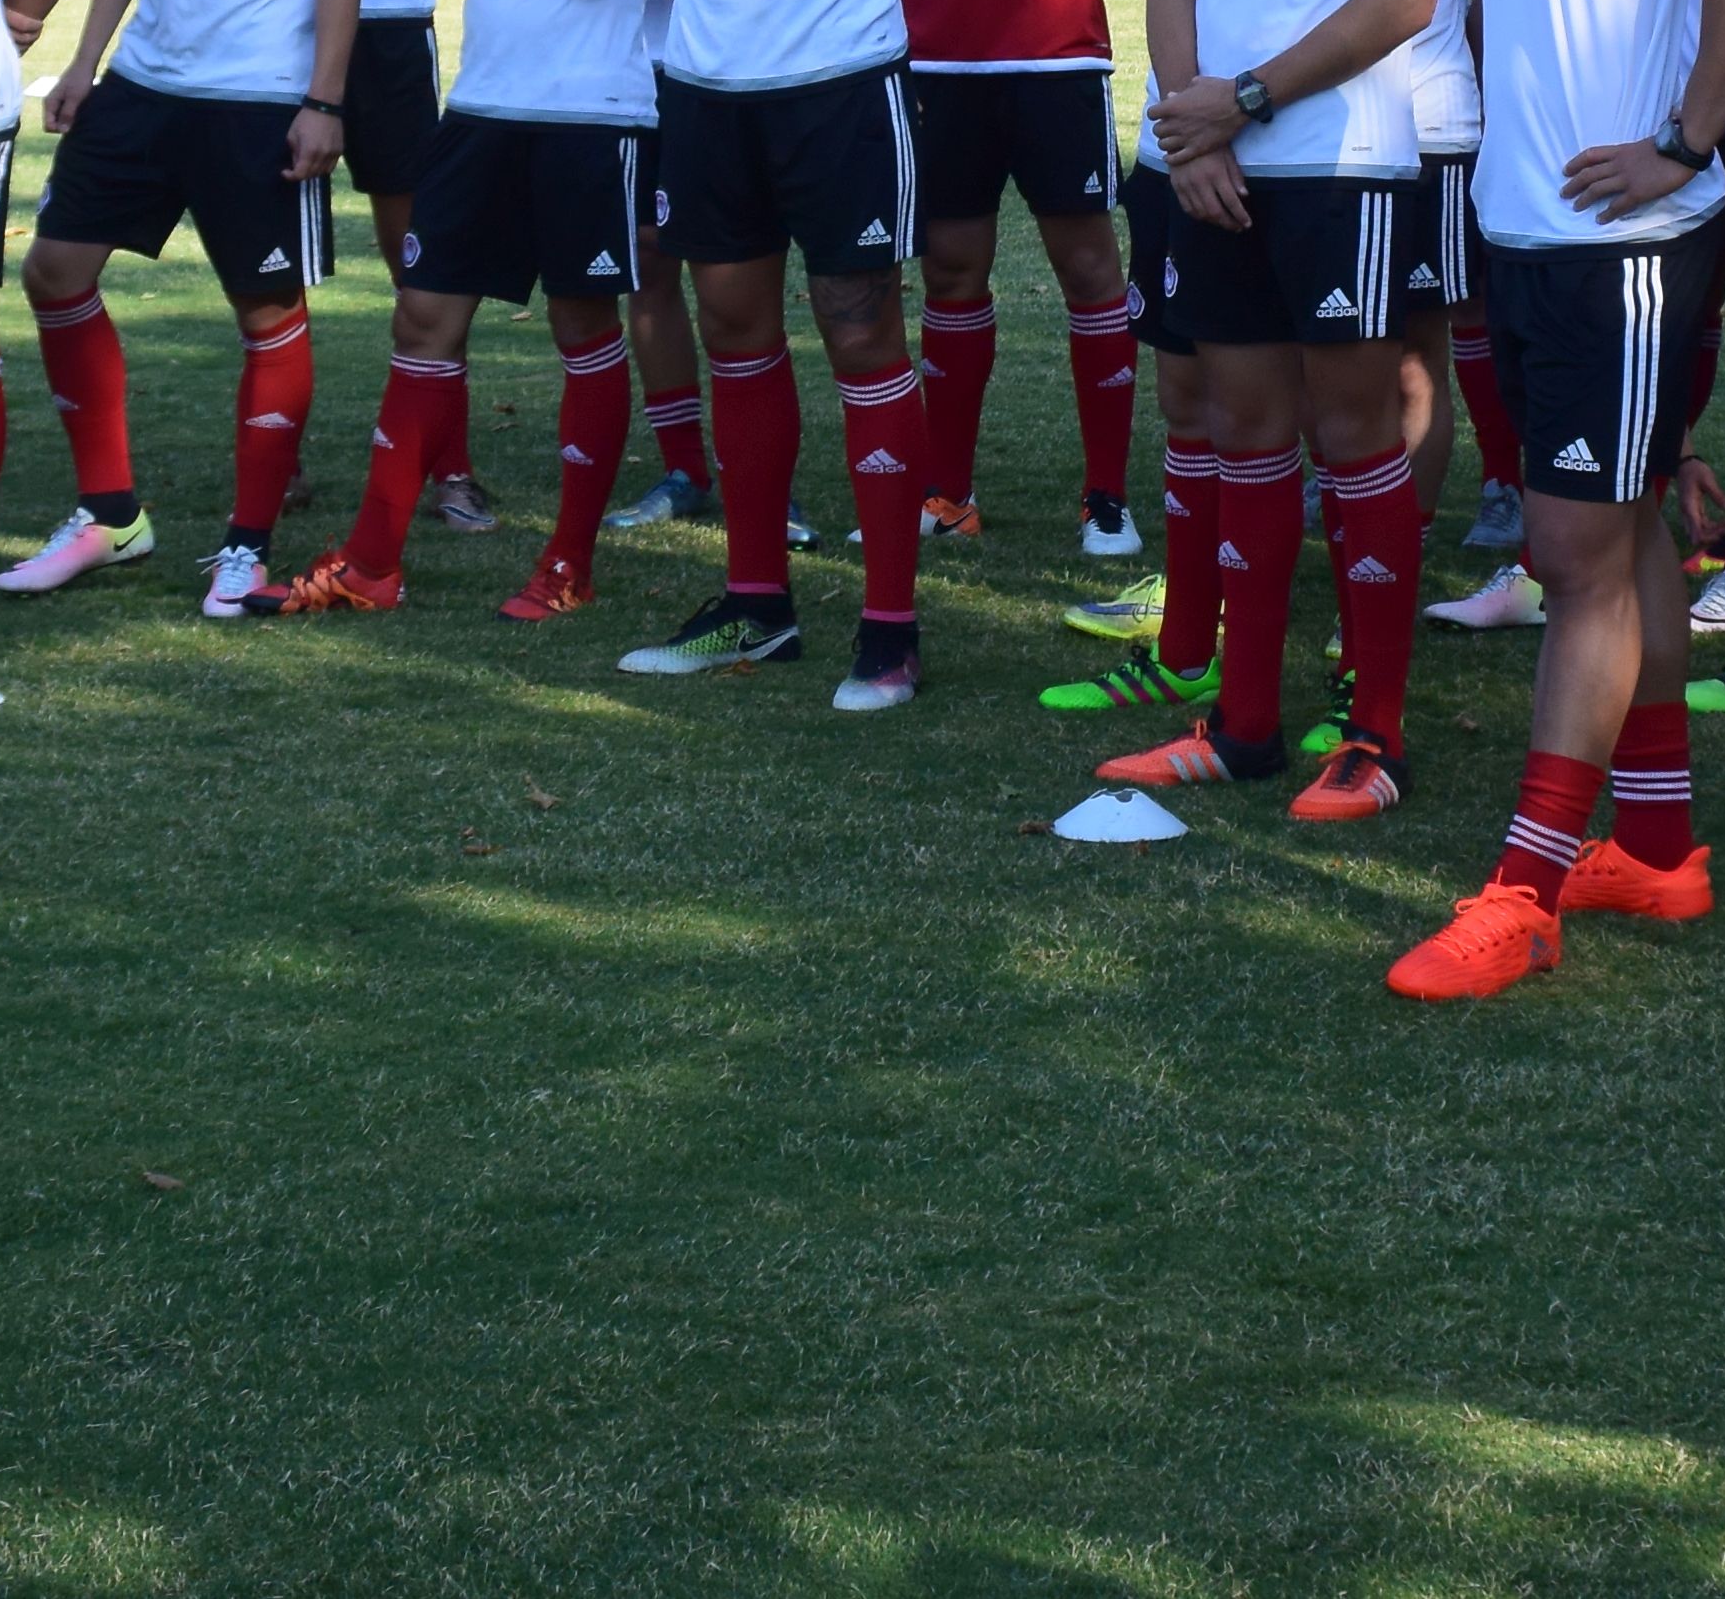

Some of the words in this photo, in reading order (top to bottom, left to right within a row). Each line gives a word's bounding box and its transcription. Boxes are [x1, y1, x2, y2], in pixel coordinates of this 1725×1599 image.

[857, 233, 892, 246] adidas
[586, 266, 621, 275] adidas
[1315, 306, 1359, 319] adidas
[1553, 457, 1601, 473] adidas
